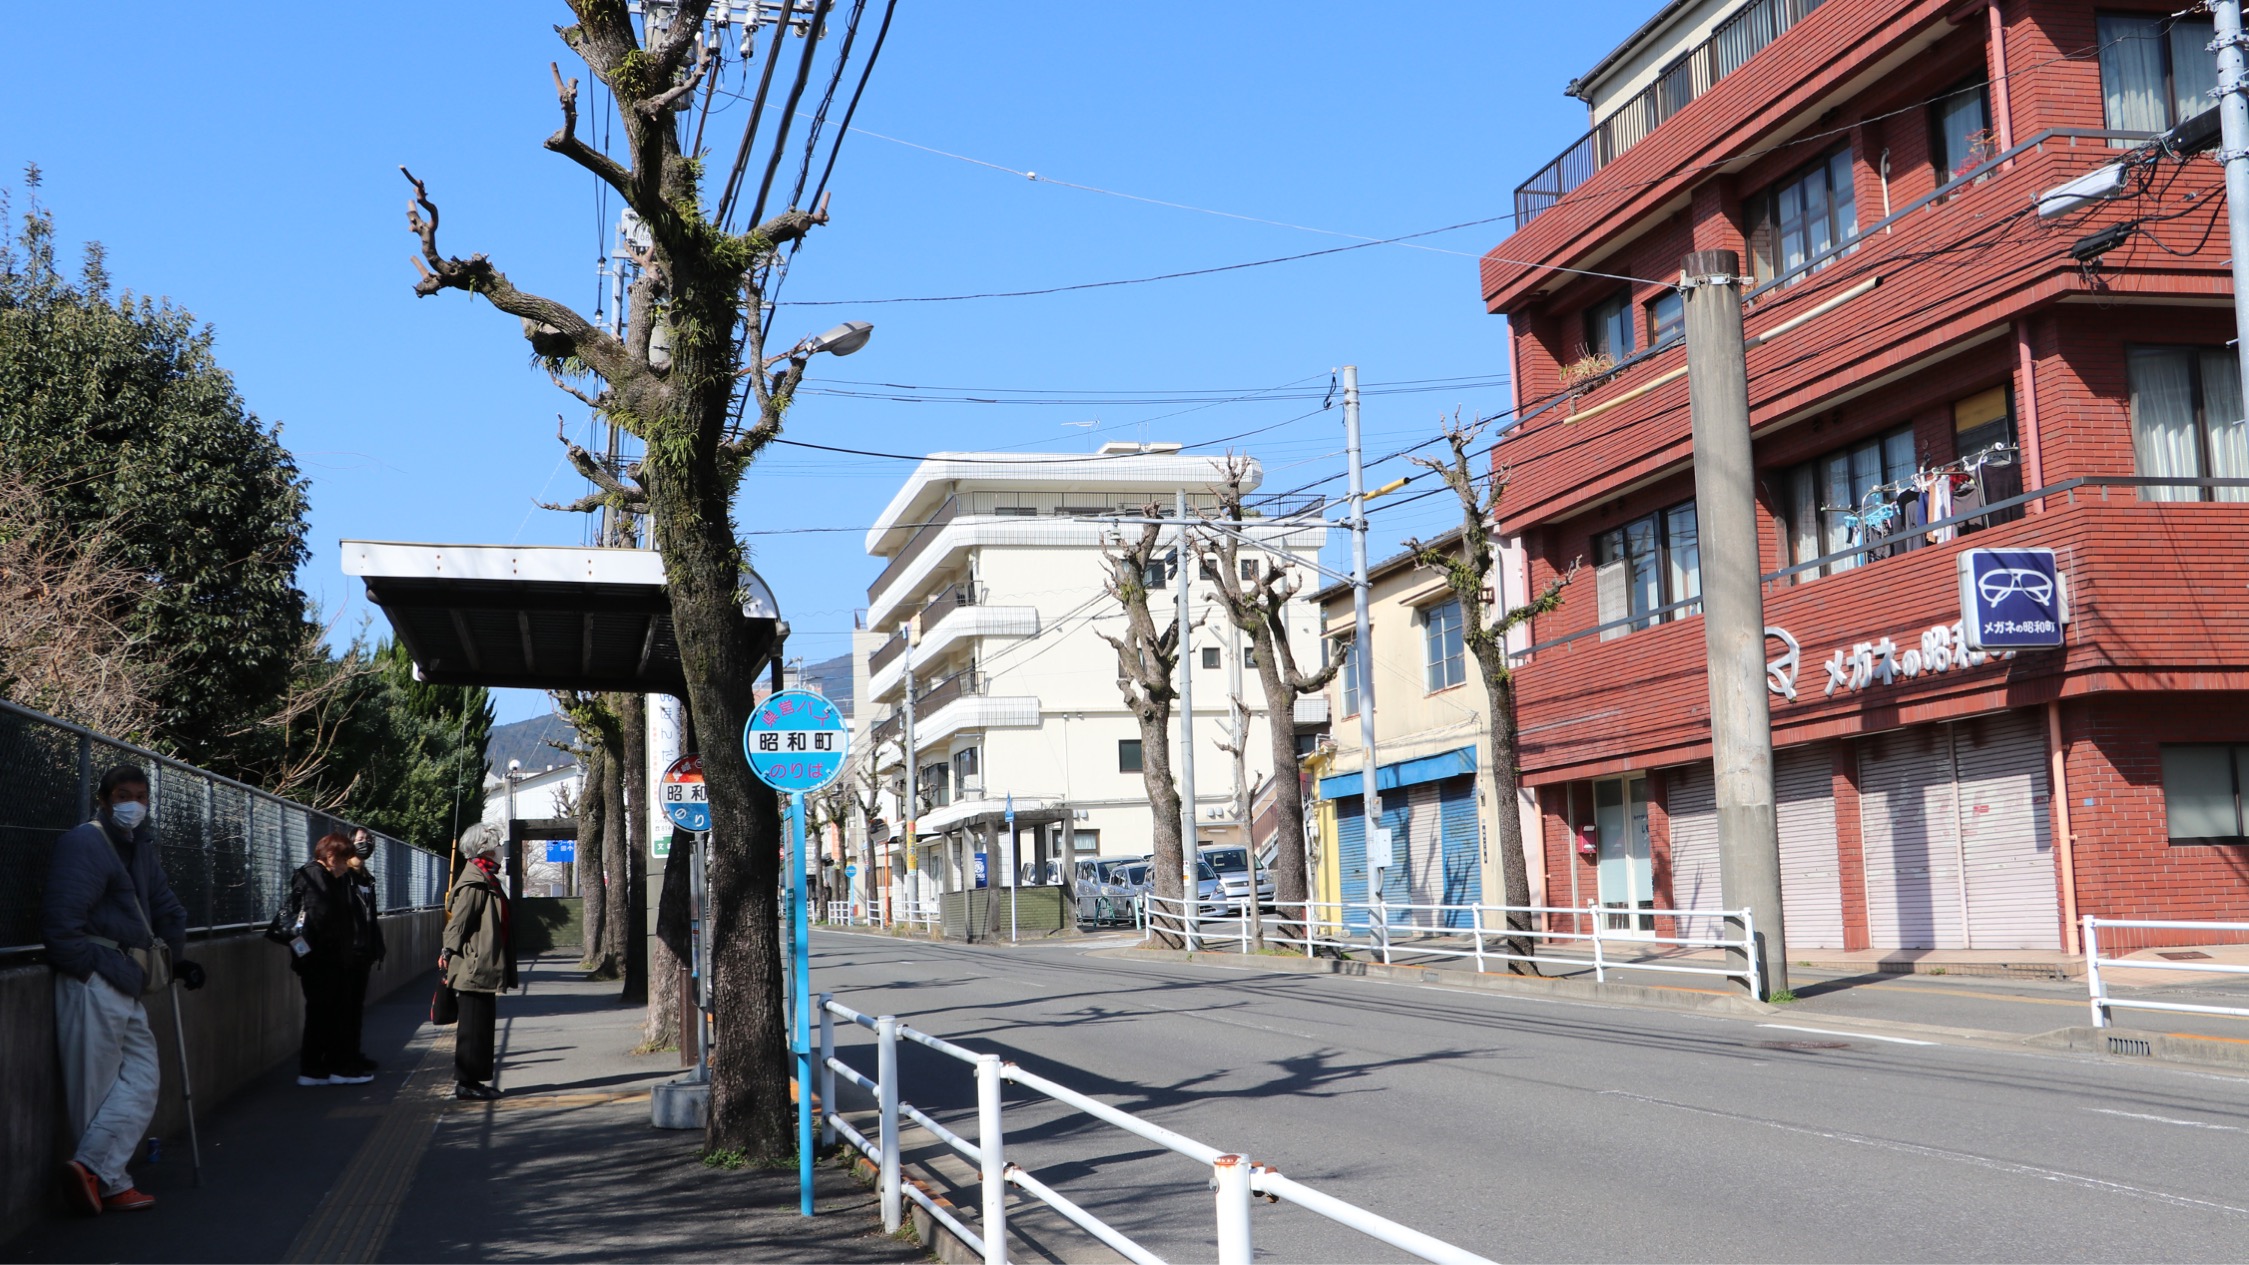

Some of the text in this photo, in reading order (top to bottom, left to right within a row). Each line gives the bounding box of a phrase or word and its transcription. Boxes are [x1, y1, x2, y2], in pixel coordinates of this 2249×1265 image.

[1984, 620, 2056, 635] メガネの昭和町
[762, 699, 830, 728] 県営バス
[760, 732, 833, 751] 昭和町
[770, 763, 823, 778] のりば
[668, 785, 707, 801] 昭和
[675, 808, 704, 827] のり
